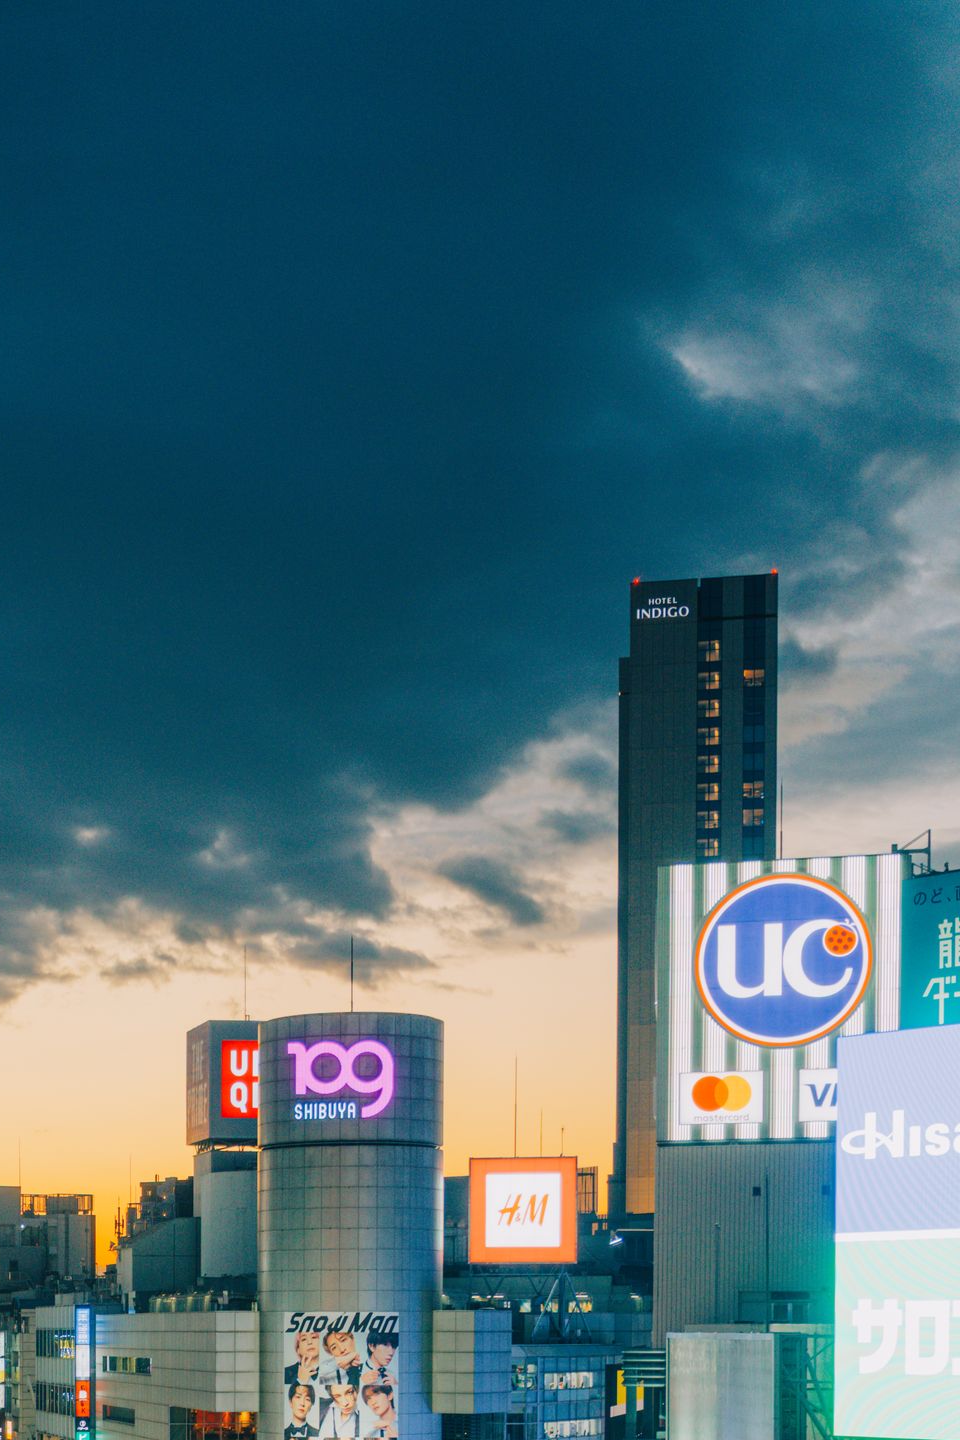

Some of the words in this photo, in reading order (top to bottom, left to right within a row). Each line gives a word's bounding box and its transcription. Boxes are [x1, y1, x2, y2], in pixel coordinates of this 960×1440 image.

[648, 597, 678, 606] HOTEL
[636, 606, 690, 620] INDIGO
[288, 1040, 394, 1118] 109
[294, 1102, 357, 1120] SHIBUYA
[694, 1112, 750, 1123] mastercard
[497, 1193, 549, 1227] H&M
[286, 1313, 346, 1332] Snow
[346, 1312, 398, 1333] Man
[852, 1298, 960, 1378] サロ
